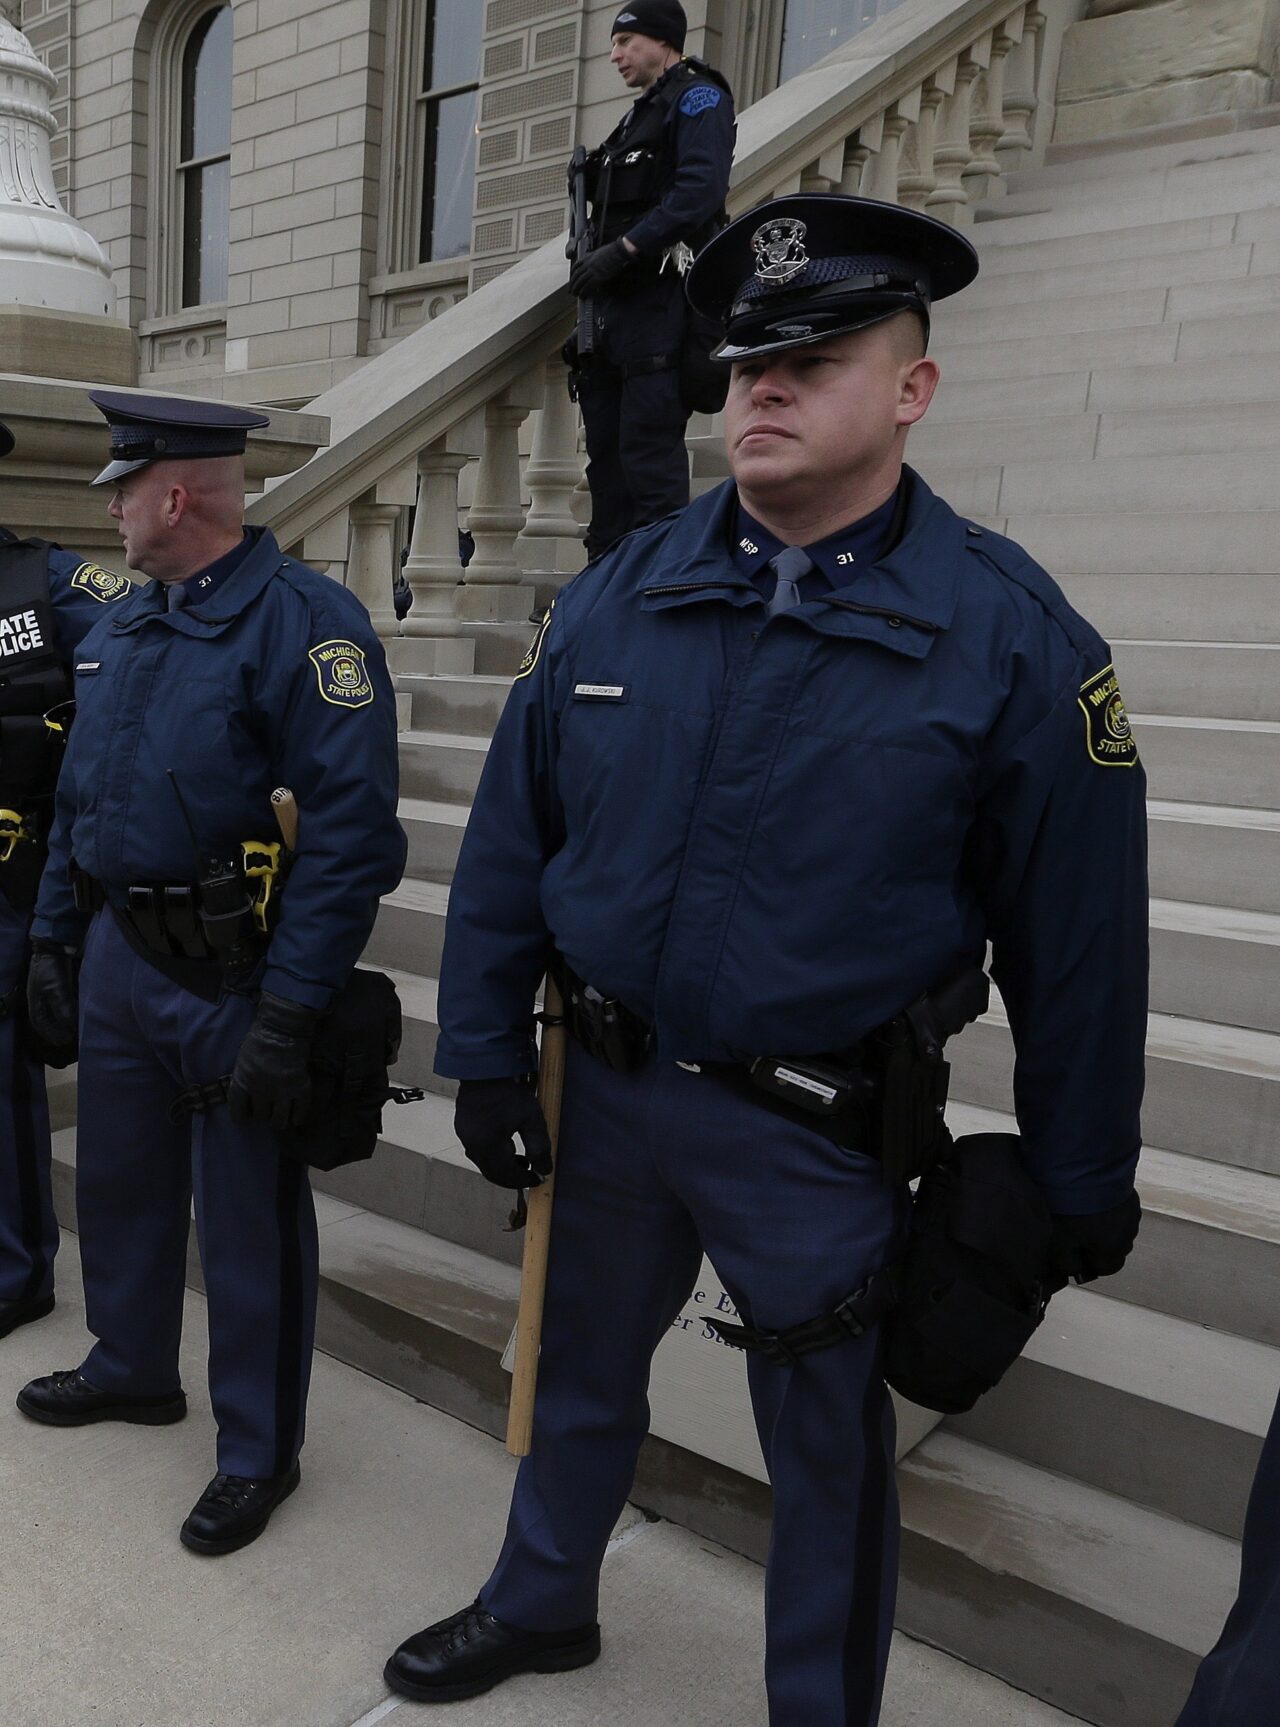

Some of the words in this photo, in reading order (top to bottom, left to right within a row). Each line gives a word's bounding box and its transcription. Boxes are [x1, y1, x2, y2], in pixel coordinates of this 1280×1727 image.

[739, 537, 759, 555] MSP
[836, 552, 855, 565] 31
[327, 684, 351, 698] STATE
